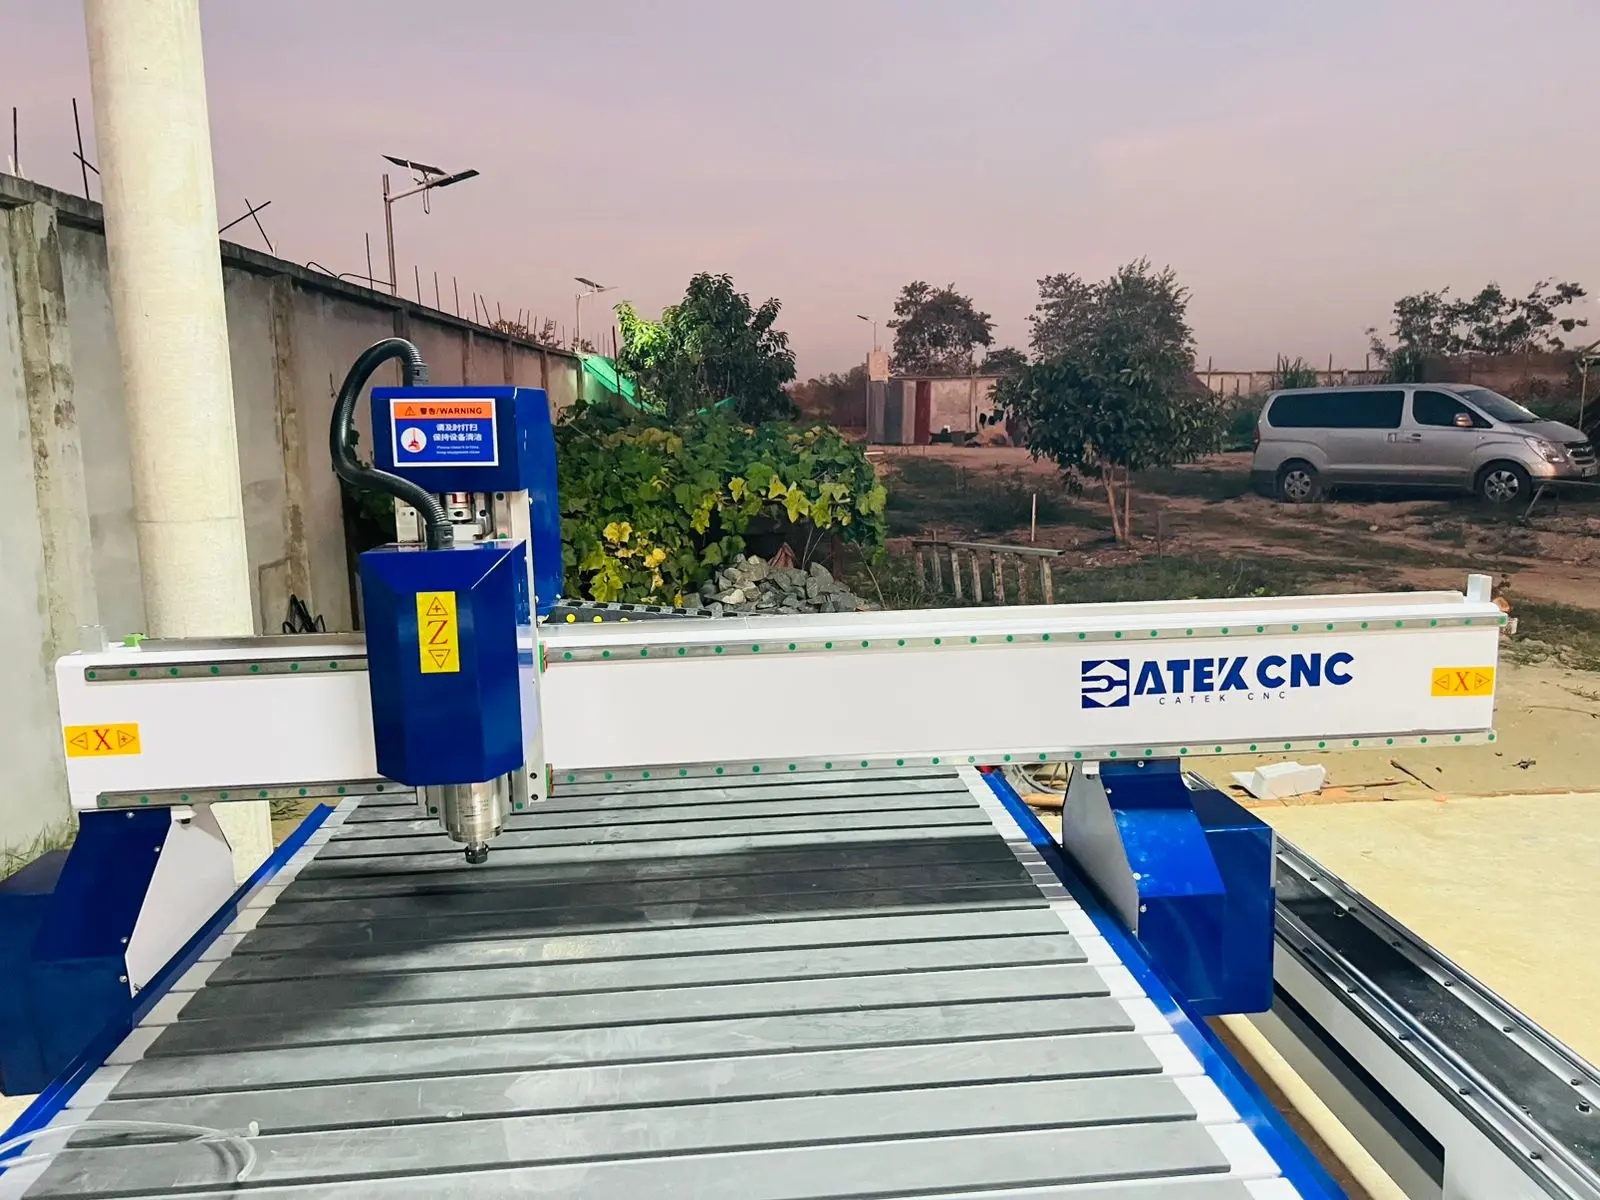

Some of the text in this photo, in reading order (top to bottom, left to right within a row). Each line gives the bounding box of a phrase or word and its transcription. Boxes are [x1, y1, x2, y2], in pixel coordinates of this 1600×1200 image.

[427, 620, 448, 644] Z
[1256, 652, 1354, 688] CNC
[1453, 671, 1470, 692] X
[1158, 691, 1286, 706] CATEK CNC
[93, 729, 114, 751] X
